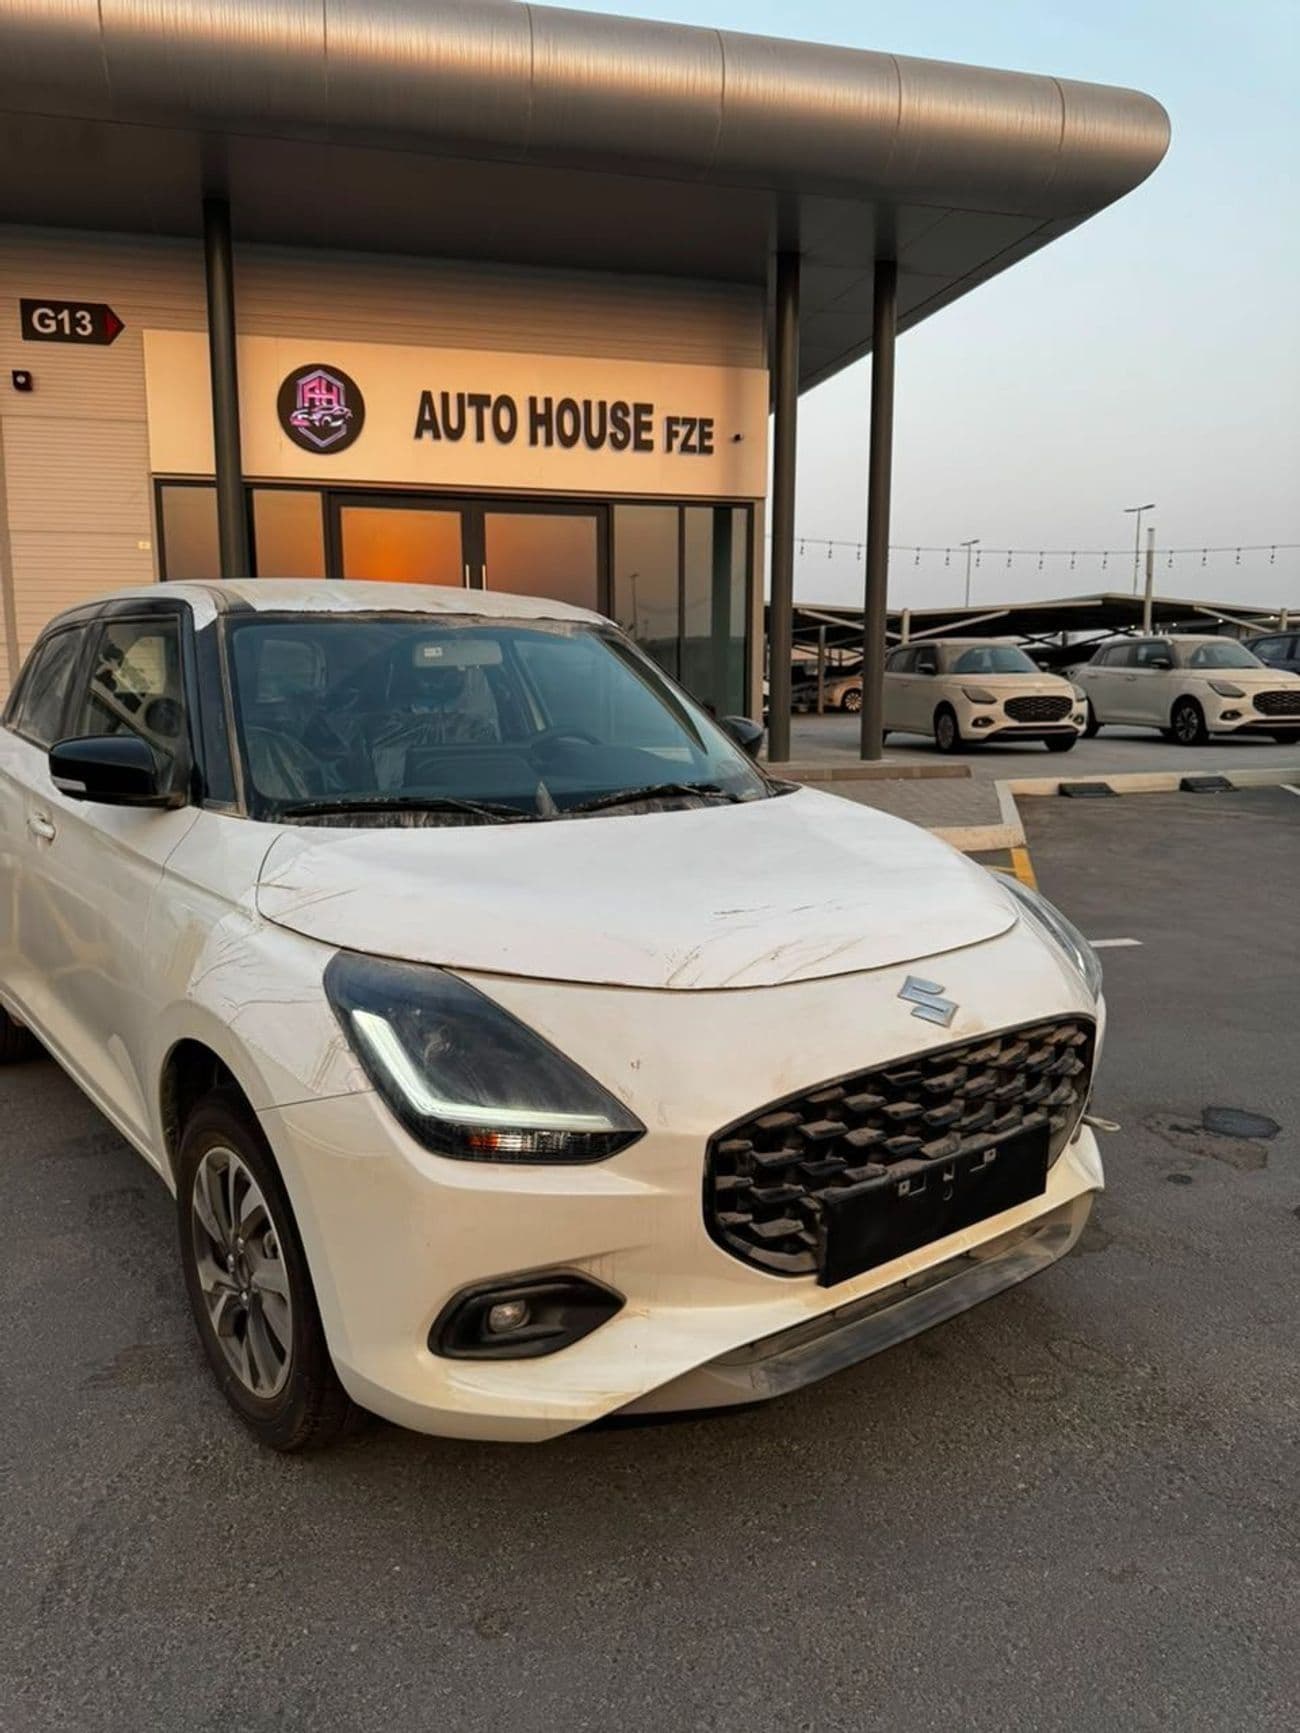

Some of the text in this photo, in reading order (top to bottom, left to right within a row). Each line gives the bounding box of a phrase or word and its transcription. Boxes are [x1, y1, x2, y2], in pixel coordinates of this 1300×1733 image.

[31, 307, 93, 336] G13
[414, 390, 714, 455] AUTO HOUSE FZE
